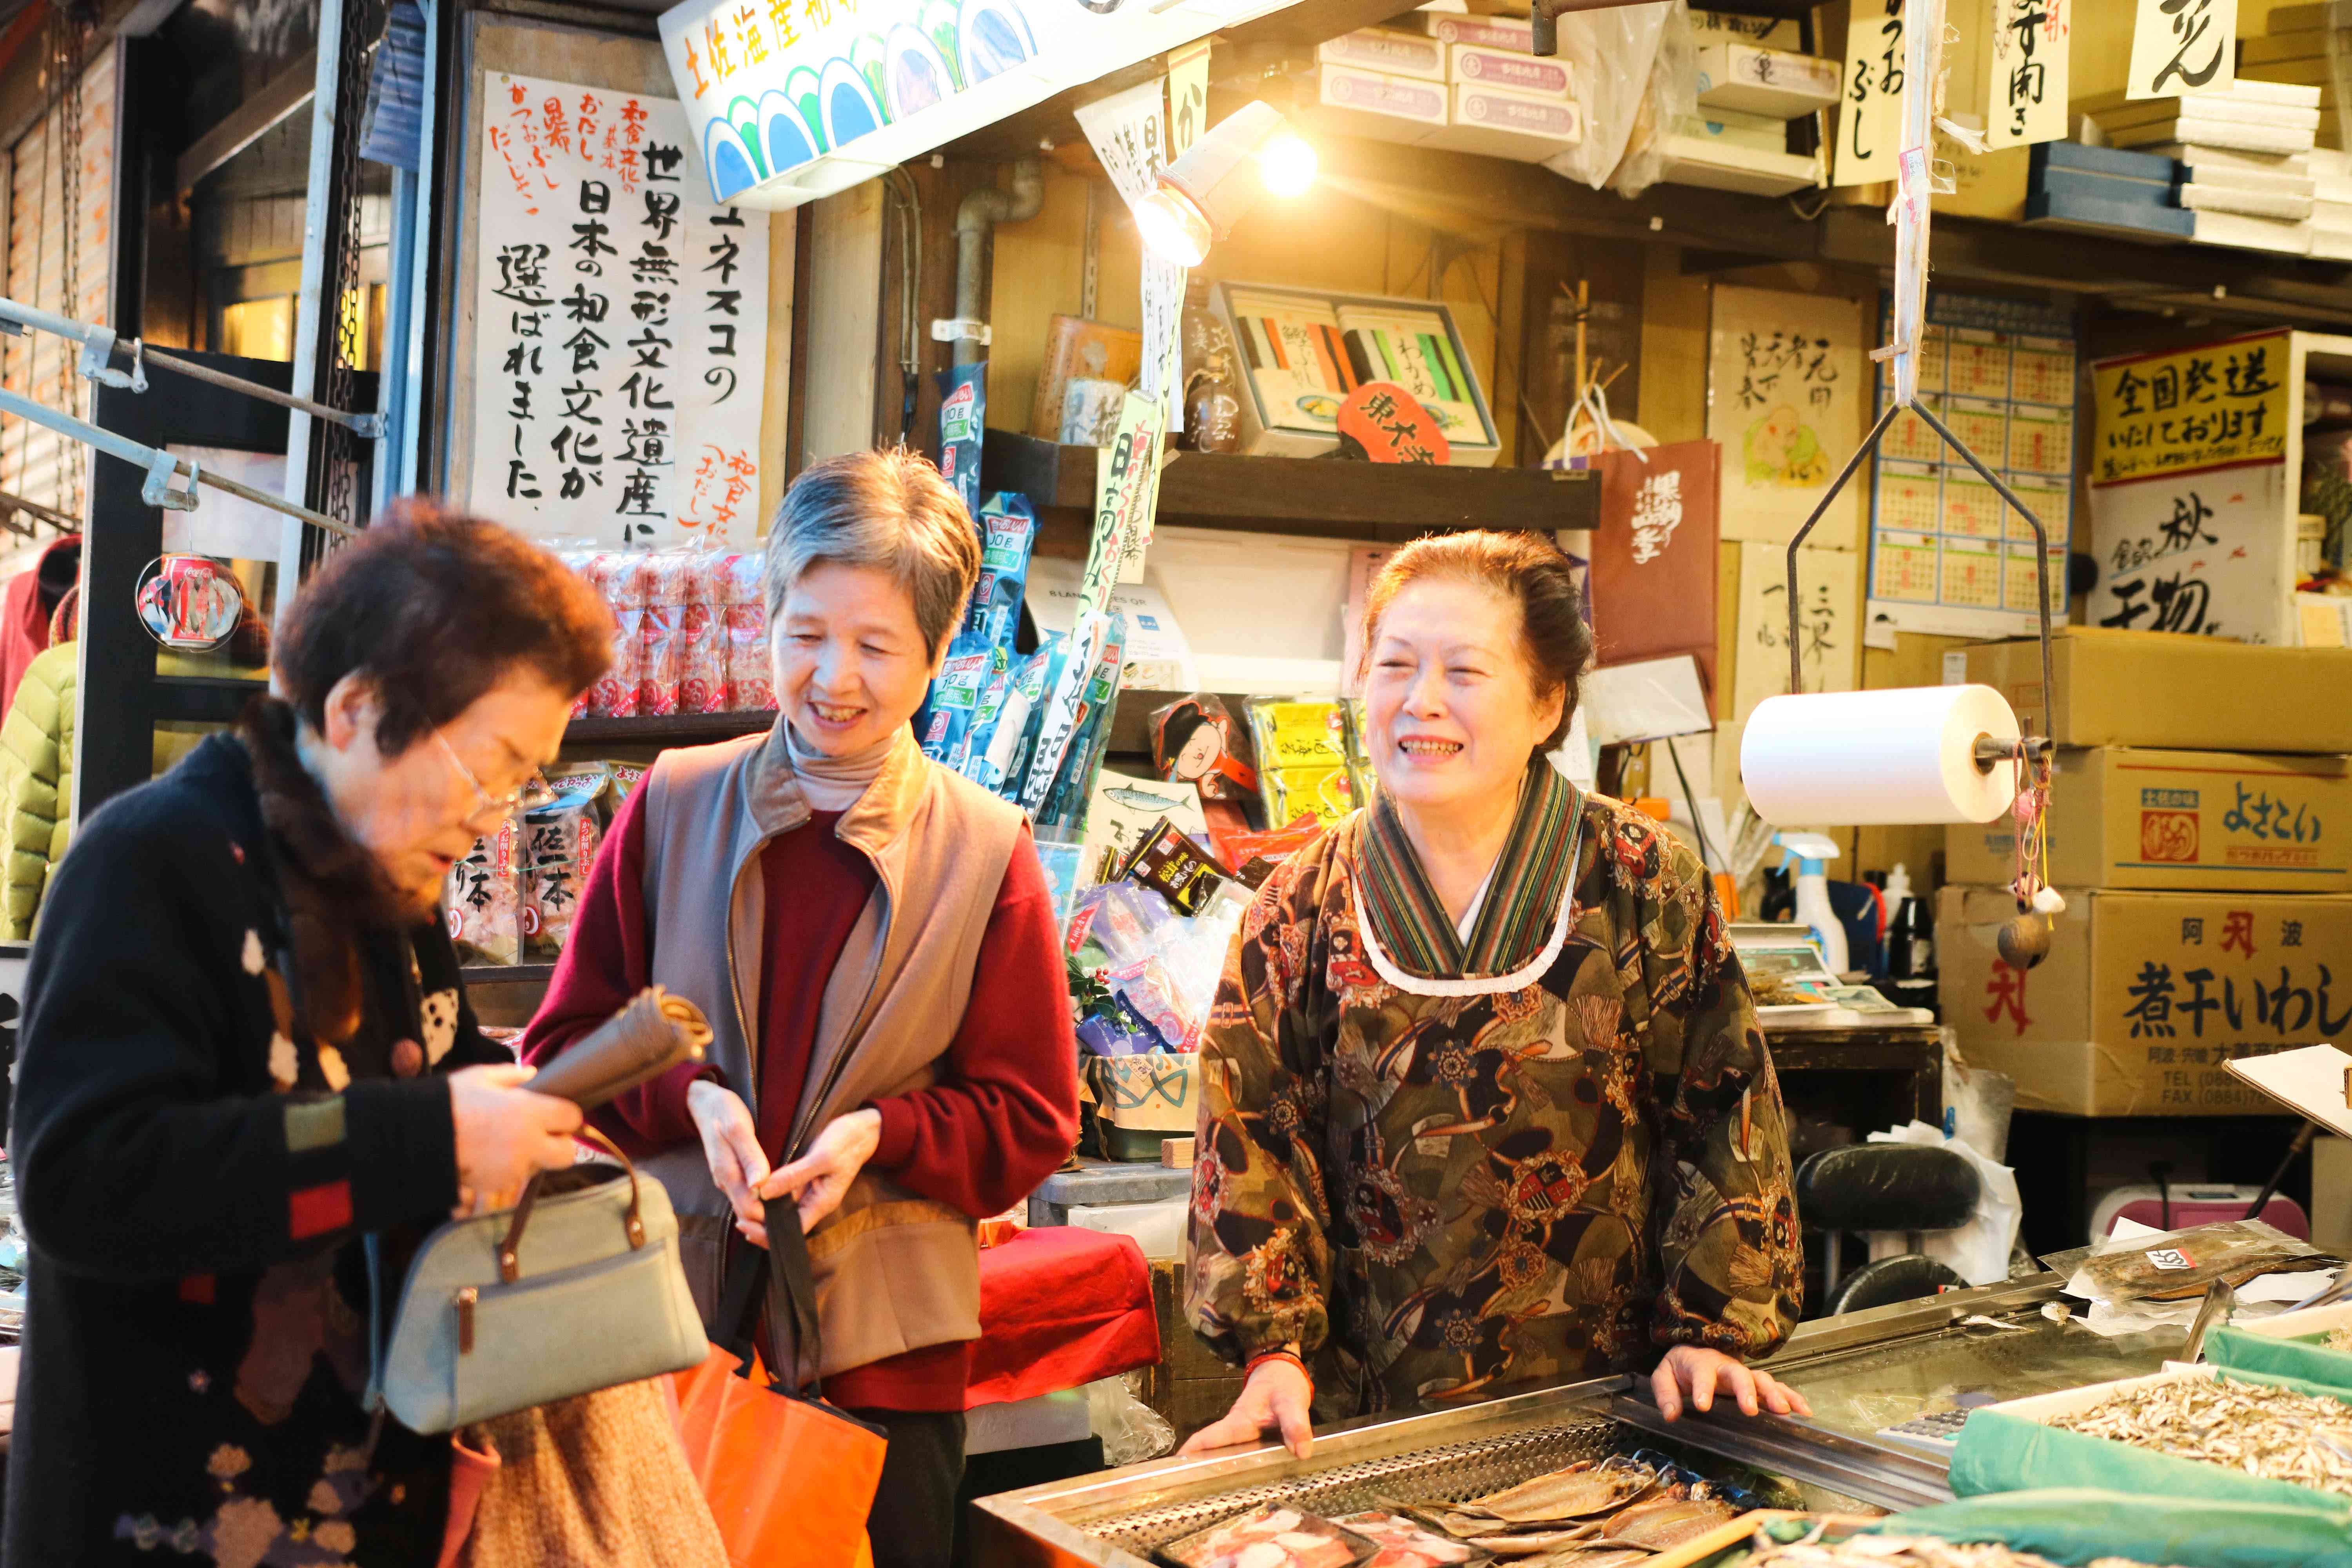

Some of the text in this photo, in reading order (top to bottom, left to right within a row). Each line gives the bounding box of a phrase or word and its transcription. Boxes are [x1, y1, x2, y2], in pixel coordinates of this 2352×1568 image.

[2009, 0, 2047, 136] す開き
[1849, 60, 1875, 160] ぶし
[551, 180, 617, 499] 日本の和食文化が
[614, 141, 683, 543] 世界無形文化遺産に
[2114, 346, 2279, 418] 全国発送
[2109, 401, 2268, 449] いたしております
[2159, 490, 2219, 551] 秋
[2223, 781, 2321, 843] よさこい
[2181, 917, 2203, 946] 阿
[2280, 918, 2303, 946] 波
[2123, 960, 2352, 1039] 煮干いわし
[2161, 1089, 2193, 1104] FAX
[2163, 1071, 2190, 1086] TEL
